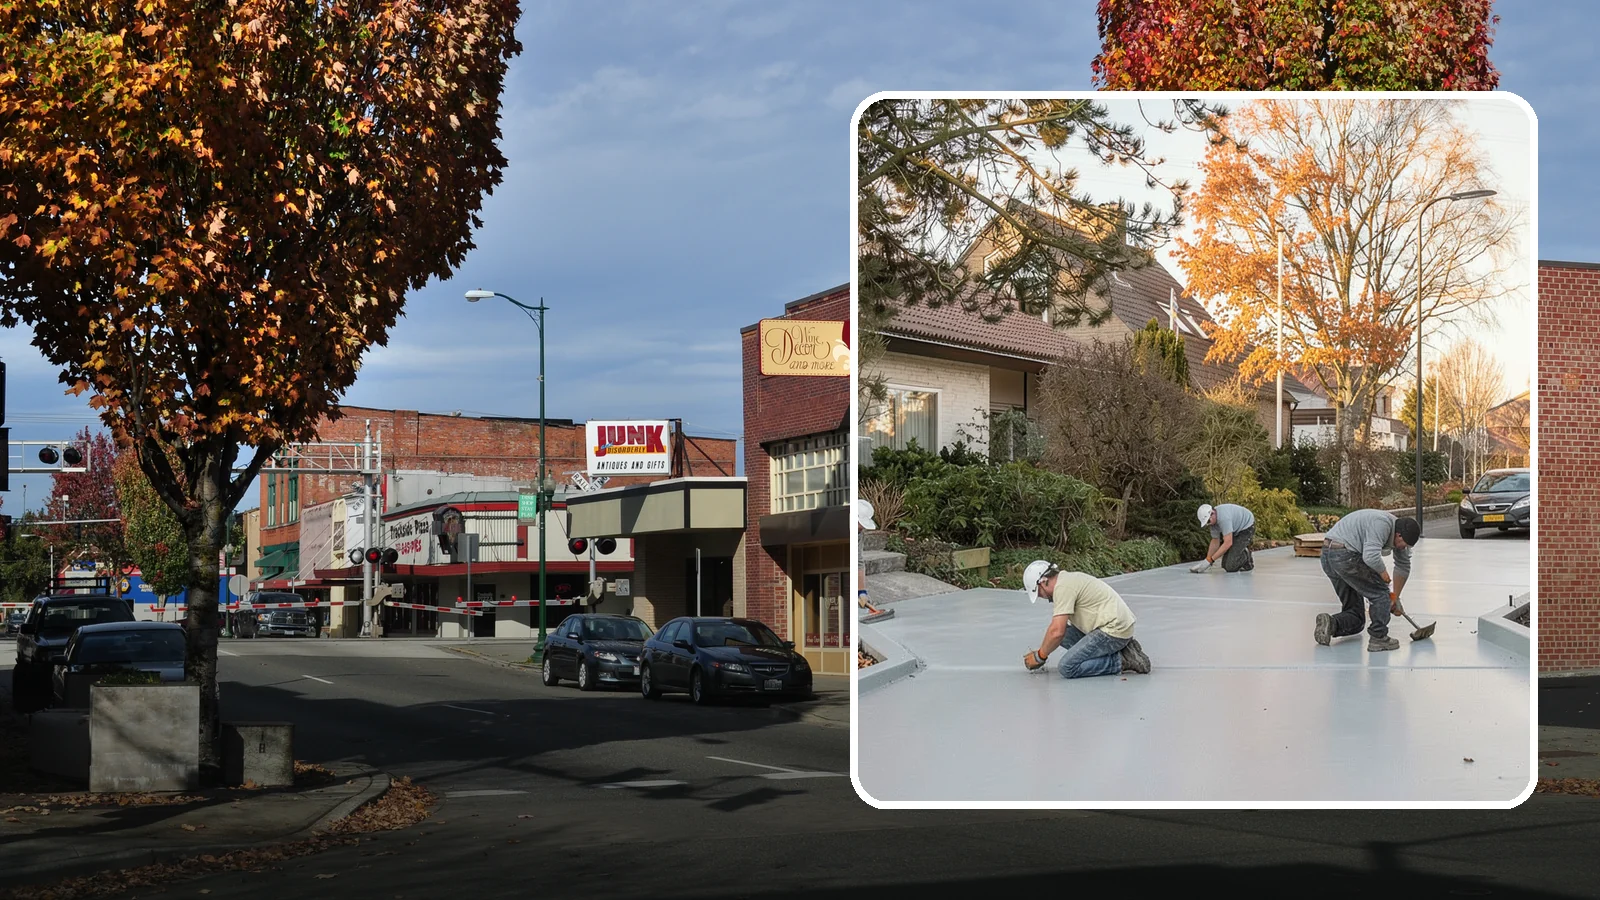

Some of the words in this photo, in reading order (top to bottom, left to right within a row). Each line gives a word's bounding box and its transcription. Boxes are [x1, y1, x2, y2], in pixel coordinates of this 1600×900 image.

[595, 425, 665, 457] JUNK
[607, 446, 646, 454] DISORDERLY
[597, 461, 628, 470] ANTIQUES
[631, 461, 644, 470] AND
[647, 460, 666, 470] GIFTS
[390, 524, 413, 540] Trackside
[414, 520, 429, 535] Pizza
